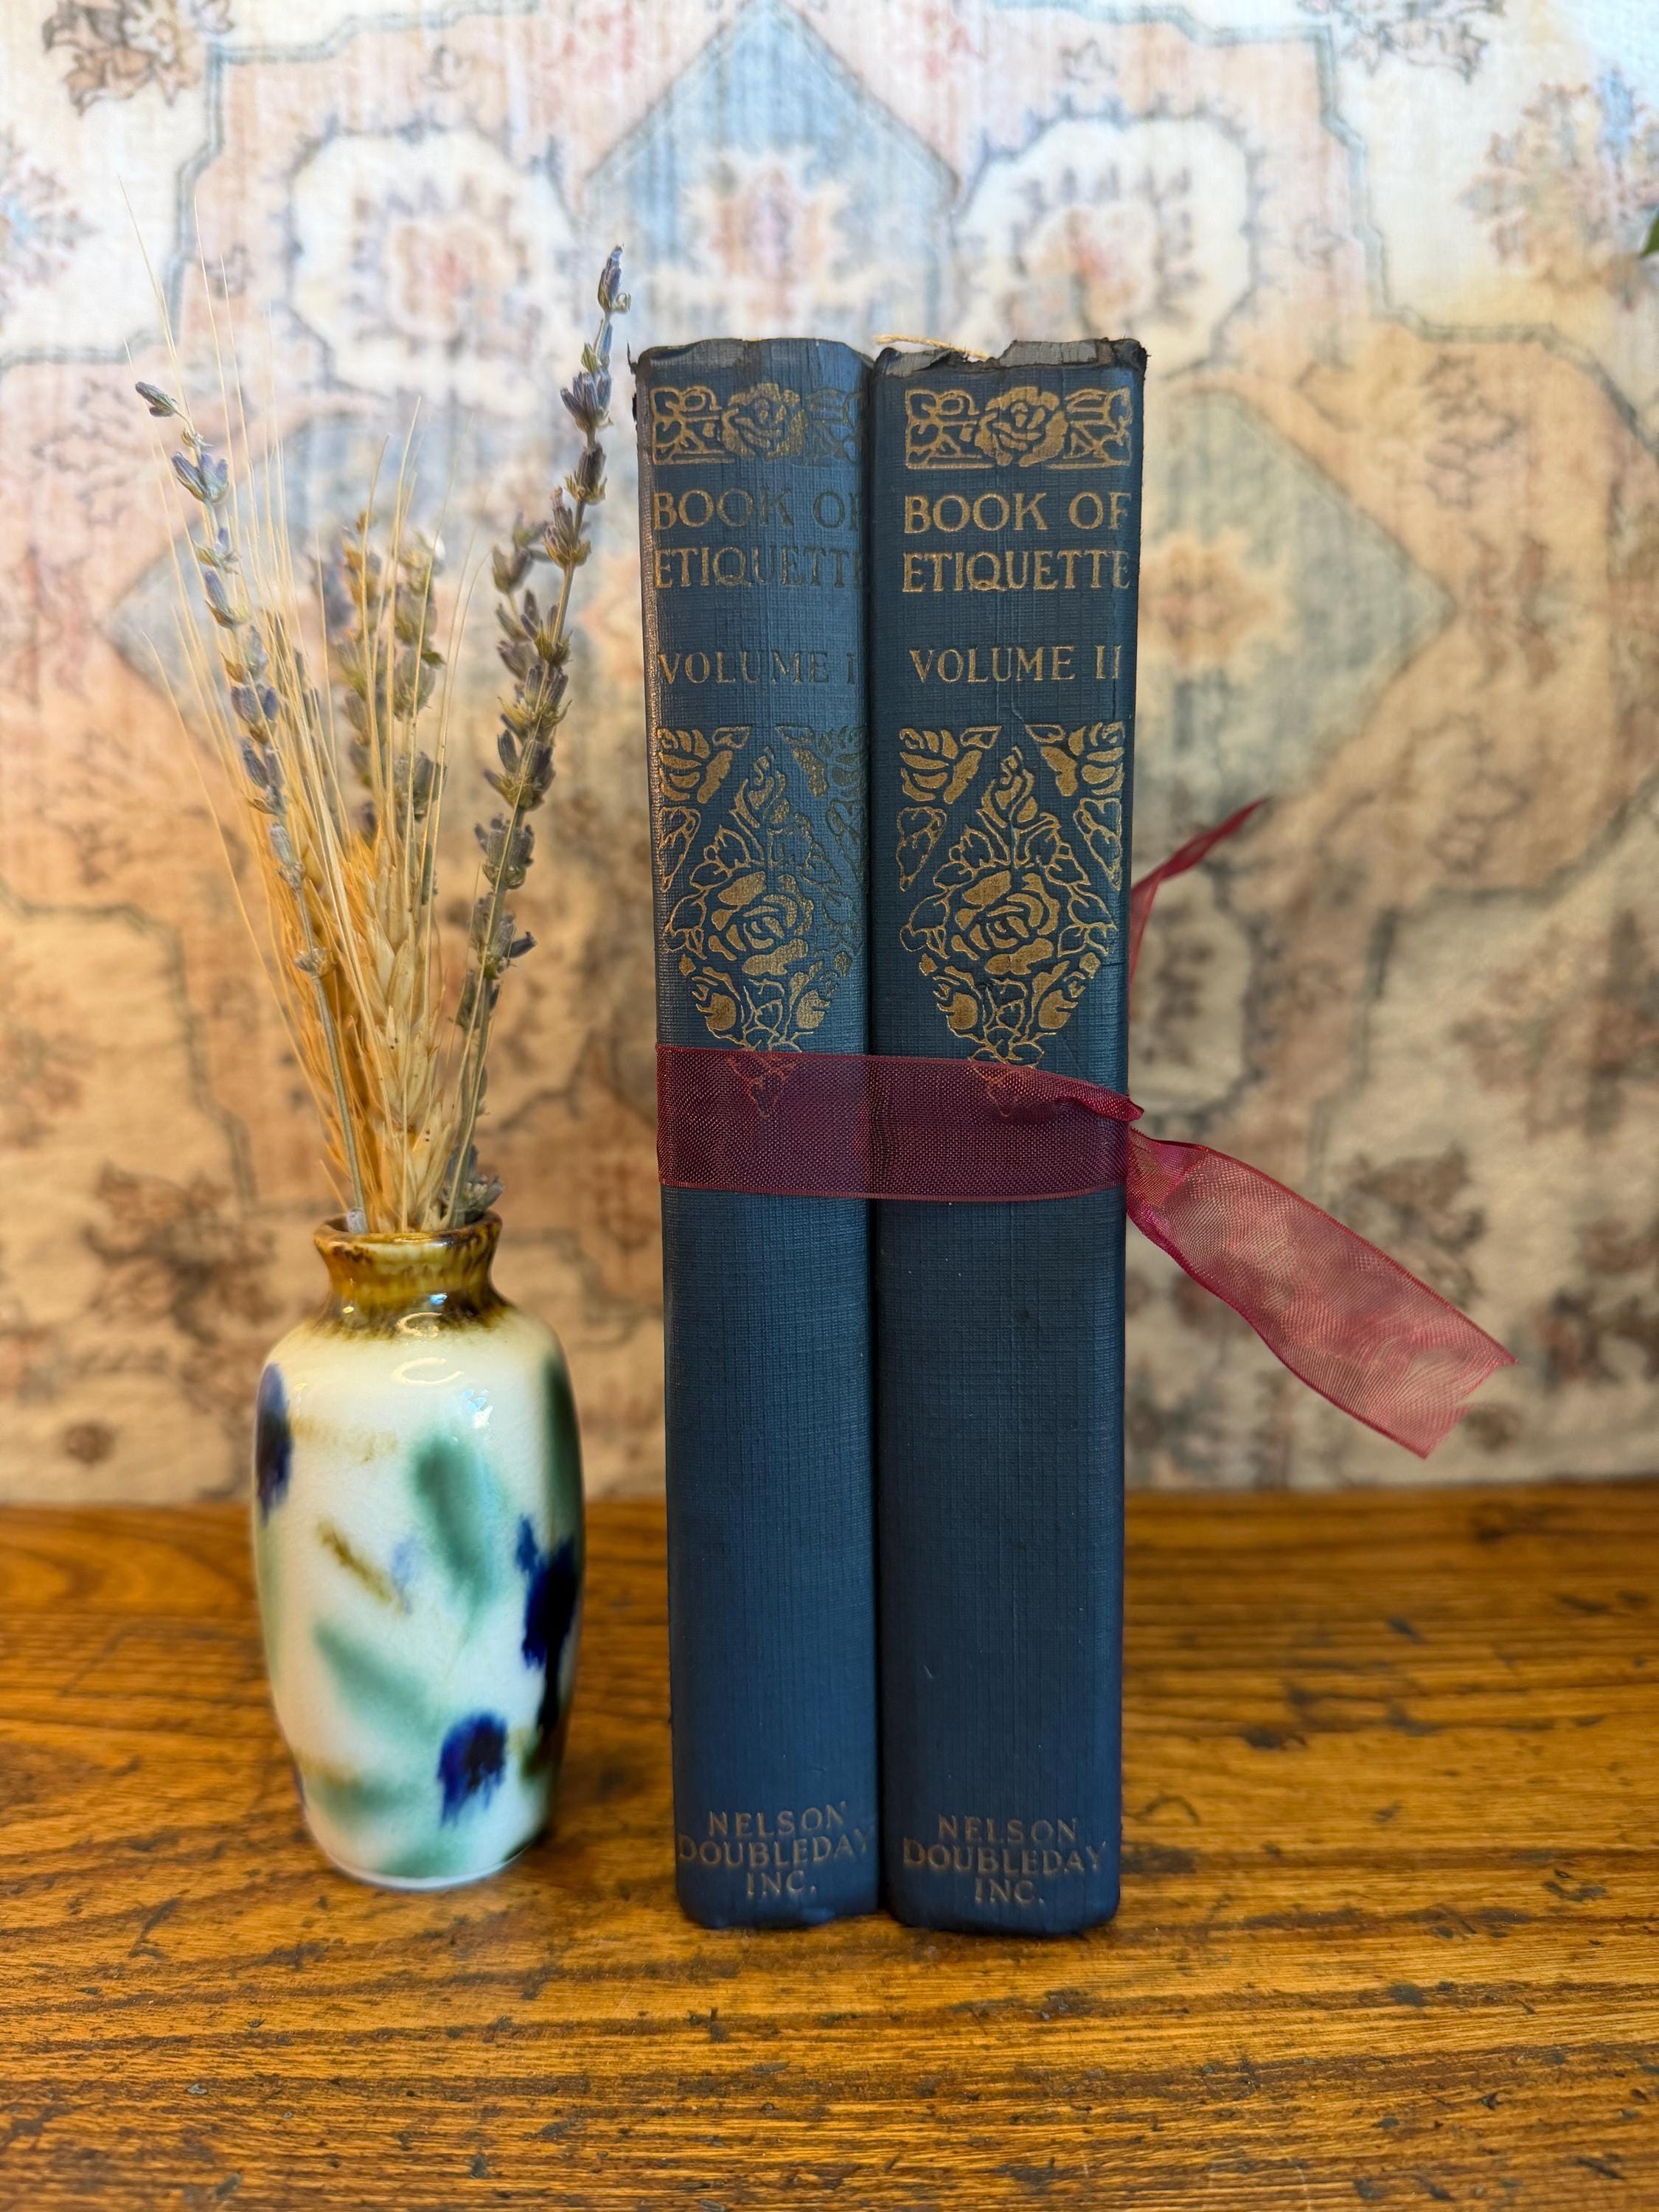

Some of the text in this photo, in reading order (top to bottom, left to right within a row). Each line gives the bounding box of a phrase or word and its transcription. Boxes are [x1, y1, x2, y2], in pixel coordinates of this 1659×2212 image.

[654, 487, 793, 531] BOOK
[904, 491, 1133, 534] BOOK OF
[902, 549, 1130, 592] ETIQUETTE
[657, 649, 829, 684] VOLUME
[909, 644, 1121, 683] VOLUME II
[708, 1801, 846, 1837] NELSON
[938, 1814, 1078, 1844] NELSON
[903, 1837, 1106, 1875] DOUBLEDAY
[746, 1870, 816, 1899] INC.
[974, 1878, 1046, 1908] INC.
